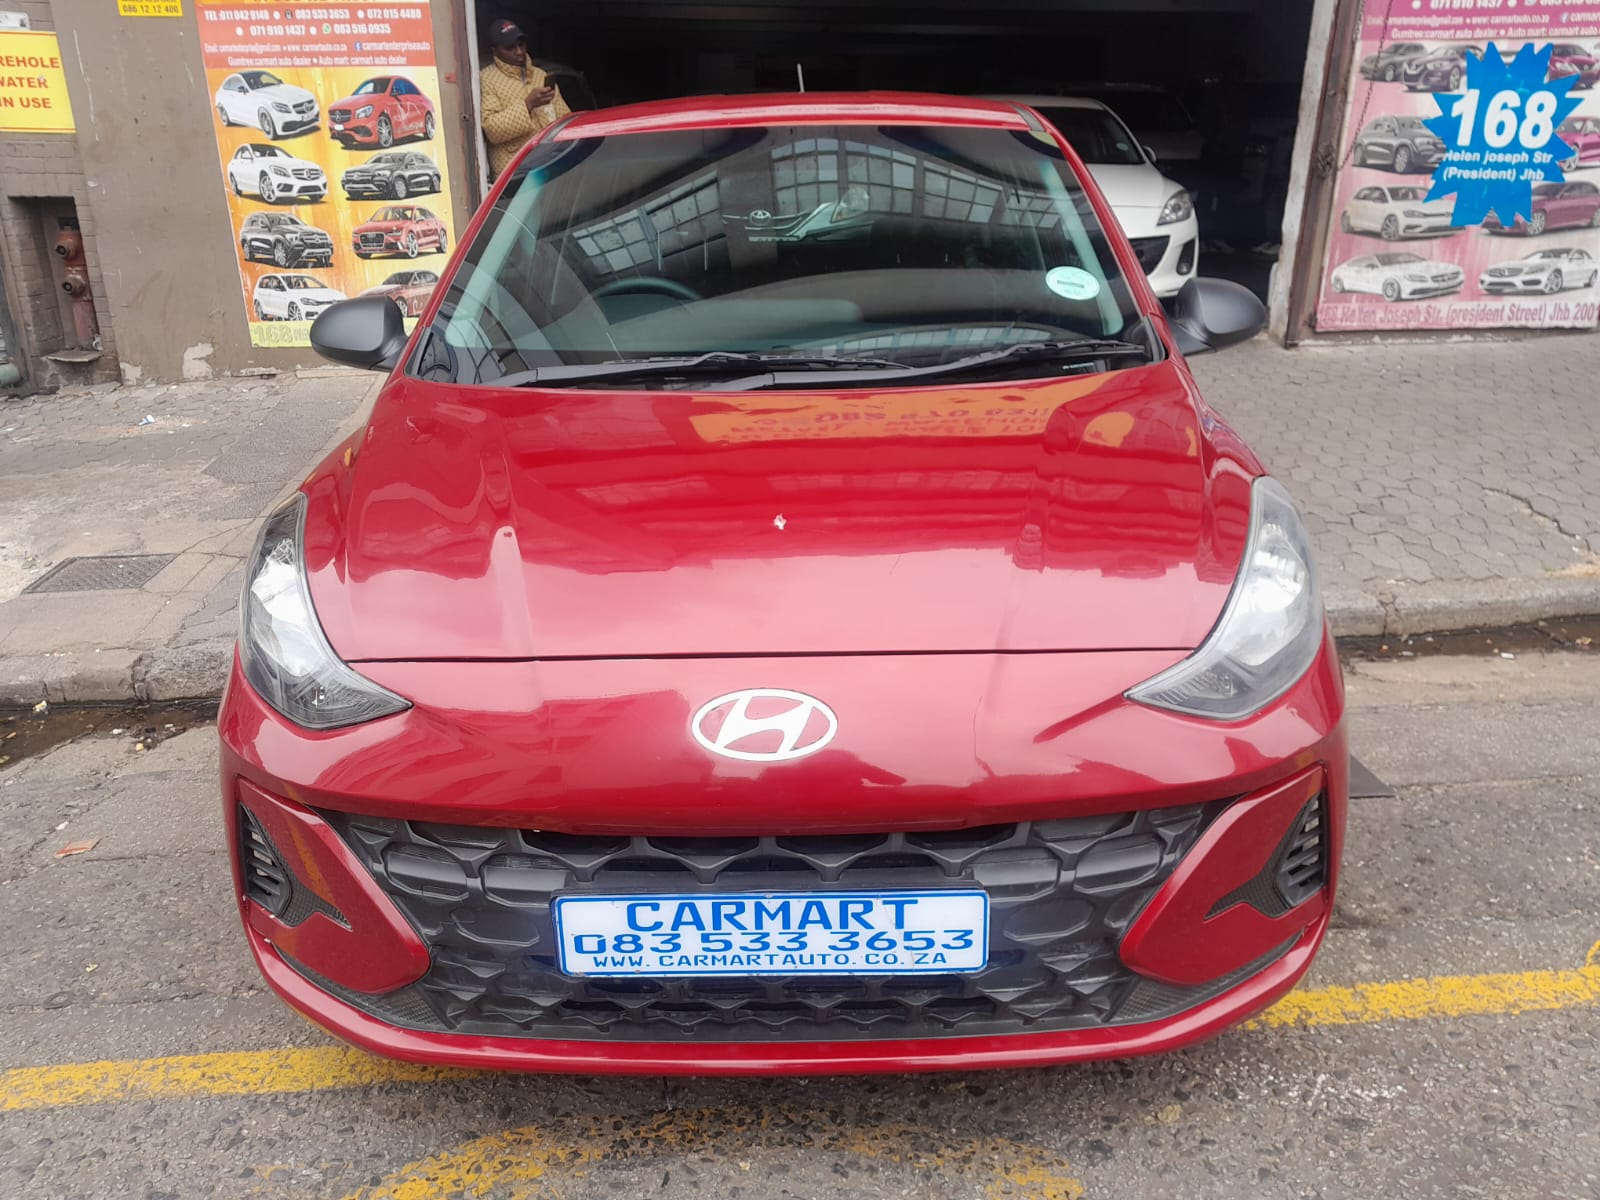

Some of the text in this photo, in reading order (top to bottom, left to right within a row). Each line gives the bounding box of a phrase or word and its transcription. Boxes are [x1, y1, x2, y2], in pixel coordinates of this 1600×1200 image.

[140, 4, 149, 13] 12
[152, 4, 161, 13] 12
[234, 9, 249, 20] 042
[295, 9, 311, 20] 083
[311, 8, 328, 20] 533
[329, 8, 350, 20] 3653
[367, 8, 382, 19] 072
[383, 8, 399, 19] 015
[250, 25, 266, 36] 071
[266, 25, 284, 36] 910
[334, 23, 351, 34] 083
[351, 23, 367, 34] 516
[368, 23, 391, 34] 0935
[19, 97, 52, 109] USE
[1450, 88, 1558, 149] 168
[1533, 151, 1554, 164] Str
[1442, 166, 1545, 183] (President) Jhb
[1549, 303, 1570, 322] Jhb
[625, 898, 919, 933] CARMART
[574, 928, 974, 956] 083 533 3653
